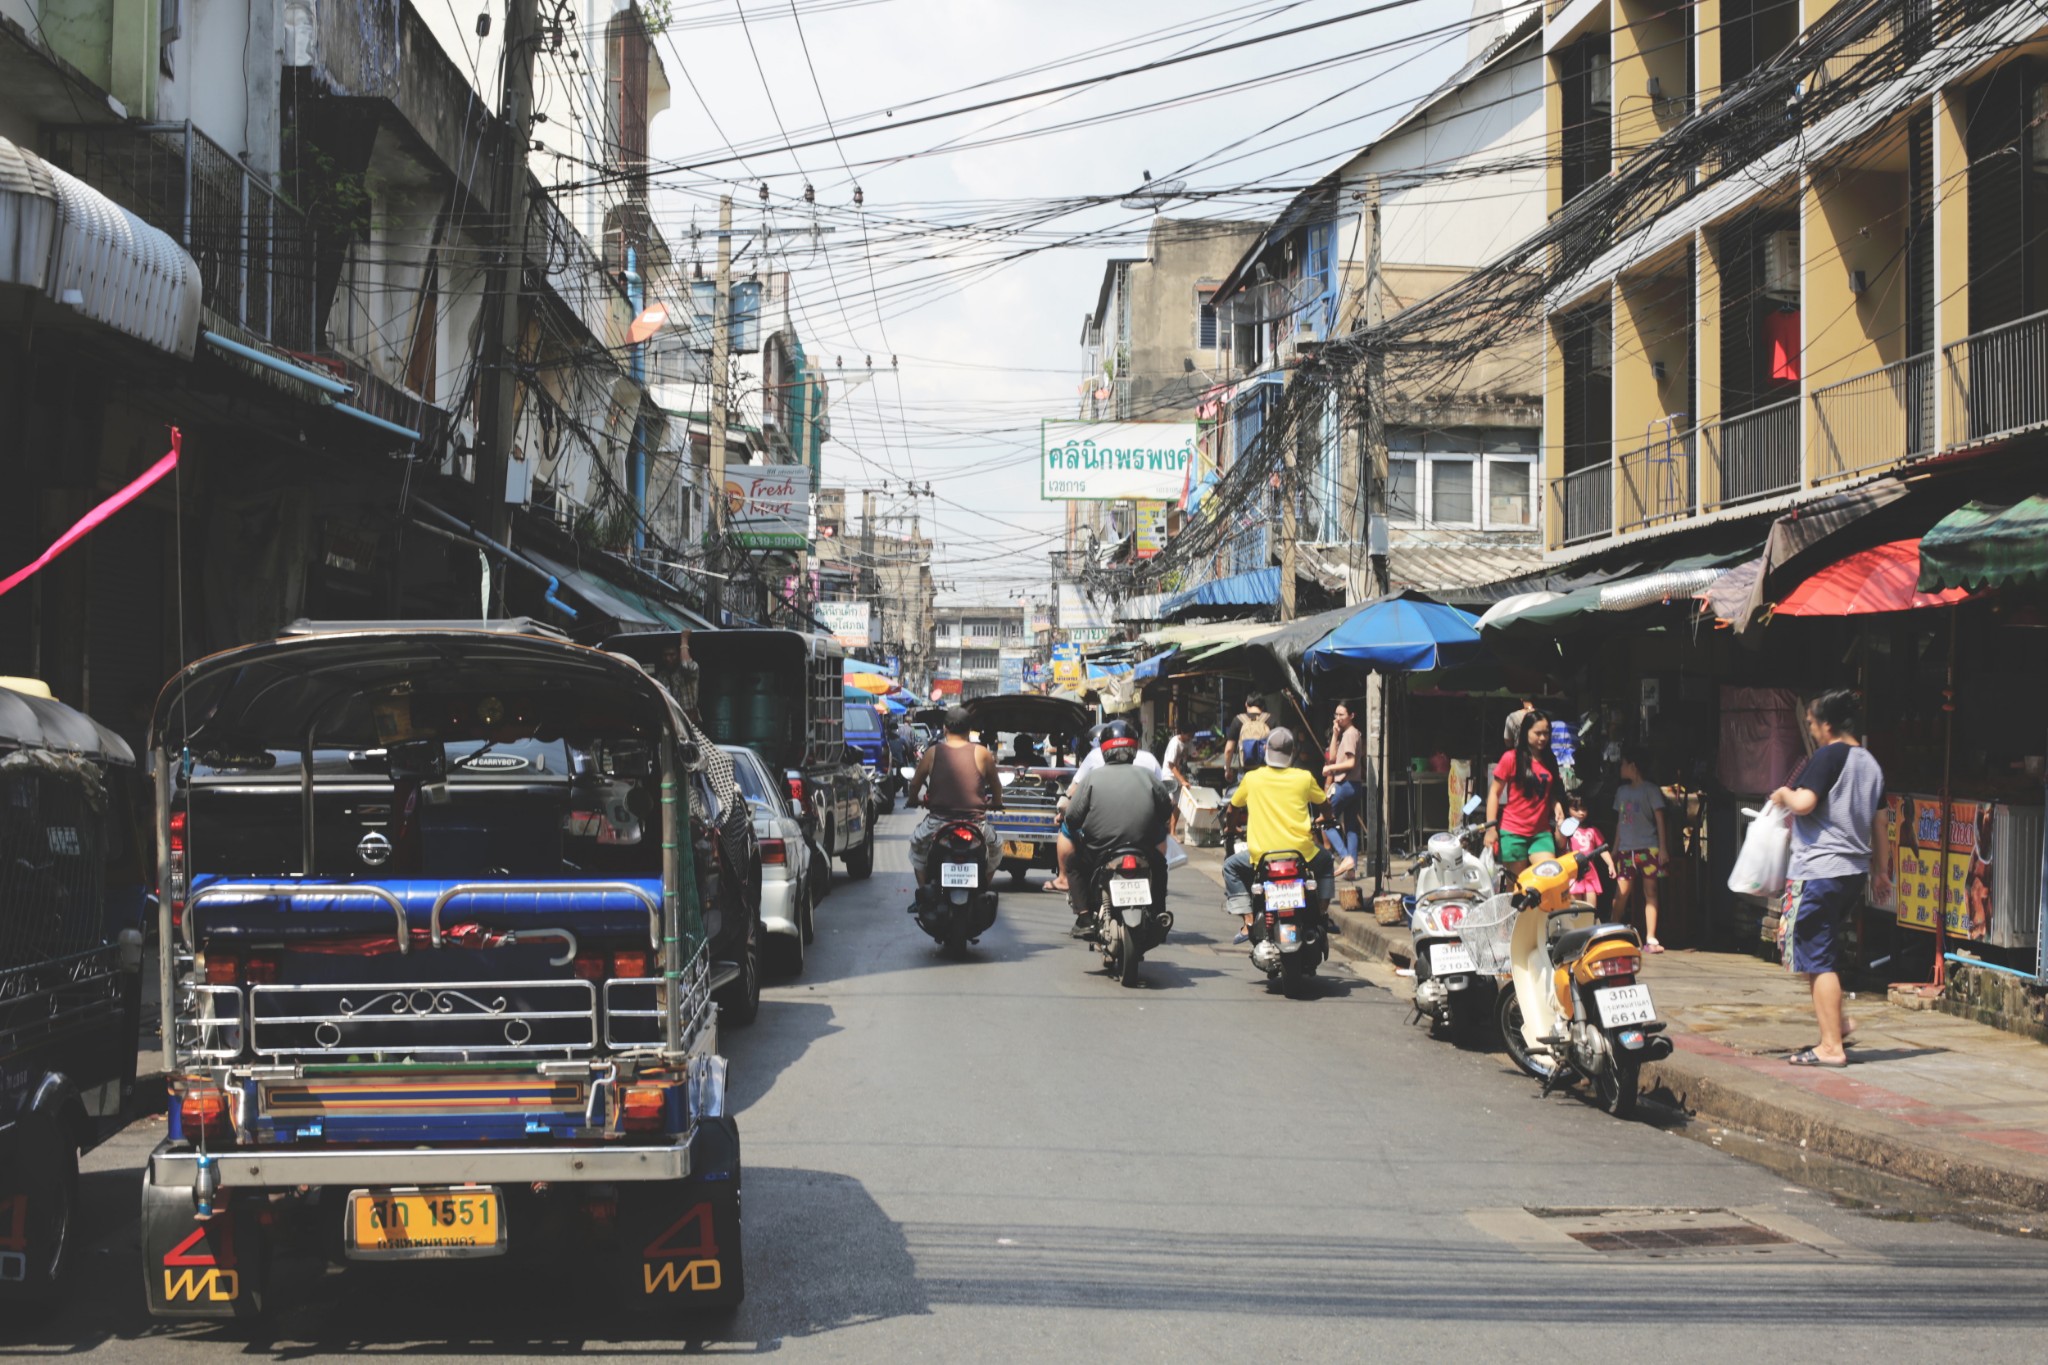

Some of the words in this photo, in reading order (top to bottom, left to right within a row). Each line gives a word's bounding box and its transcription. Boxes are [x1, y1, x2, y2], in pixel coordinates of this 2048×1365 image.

[1049, 438, 1192, 470] คลินิกพรพงศ์
[750, 476, 796, 497] Fresh
[1048, 480, 1086, 492] เวชการ
[749, 501, 793, 516] Mart
[478, 758, 517, 766] CARRYBOY
[1611, 1010, 1648, 1024] 6614
[370, 1200, 409, 1229] สก
[428, 1199, 489, 1227] 1551
[377, 1236, 476, 1249] กรุงเทพมหานคร
[164, 1268, 239, 1301] WD
[643, 1259, 722, 1294] WD
